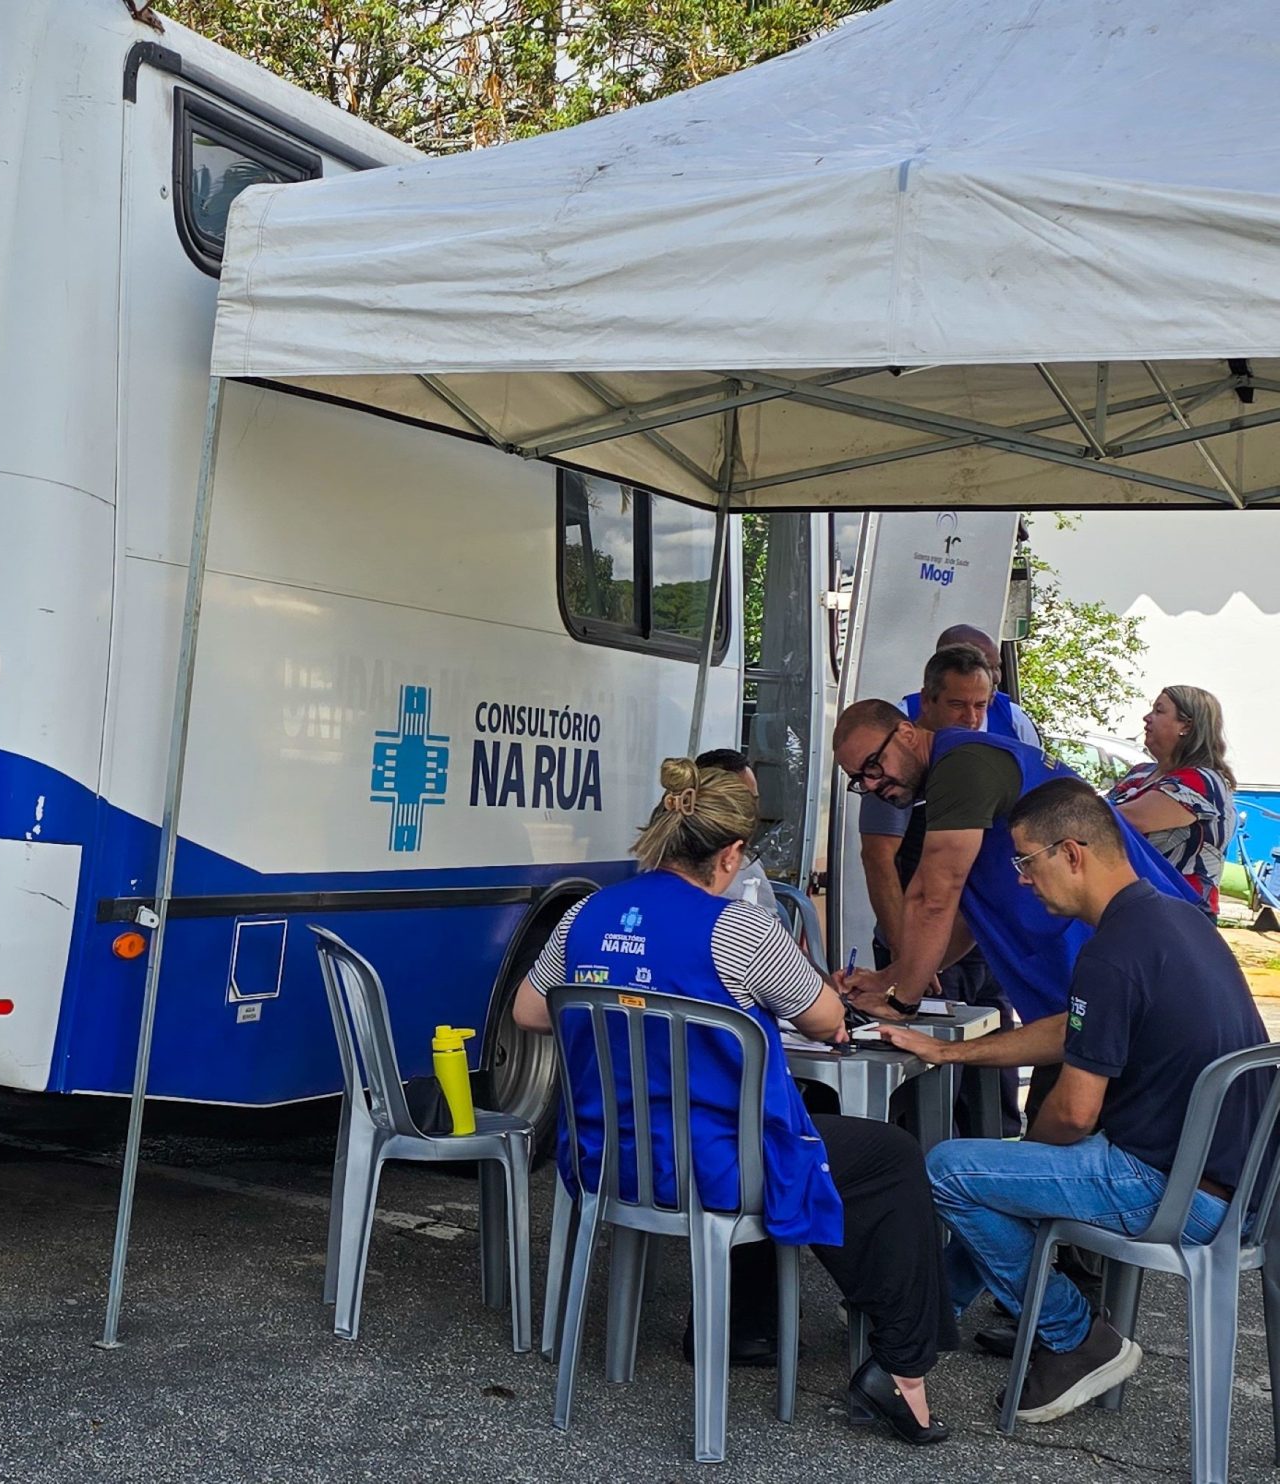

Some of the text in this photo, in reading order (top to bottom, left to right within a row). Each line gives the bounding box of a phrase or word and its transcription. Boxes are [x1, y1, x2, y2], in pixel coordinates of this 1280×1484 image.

[920, 563, 954, 586] Mogi
[475, 701, 600, 743] CONSULTÓRIO
[469, 739, 602, 812] NA RUA
[600, 939, 646, 955] NA RUA
